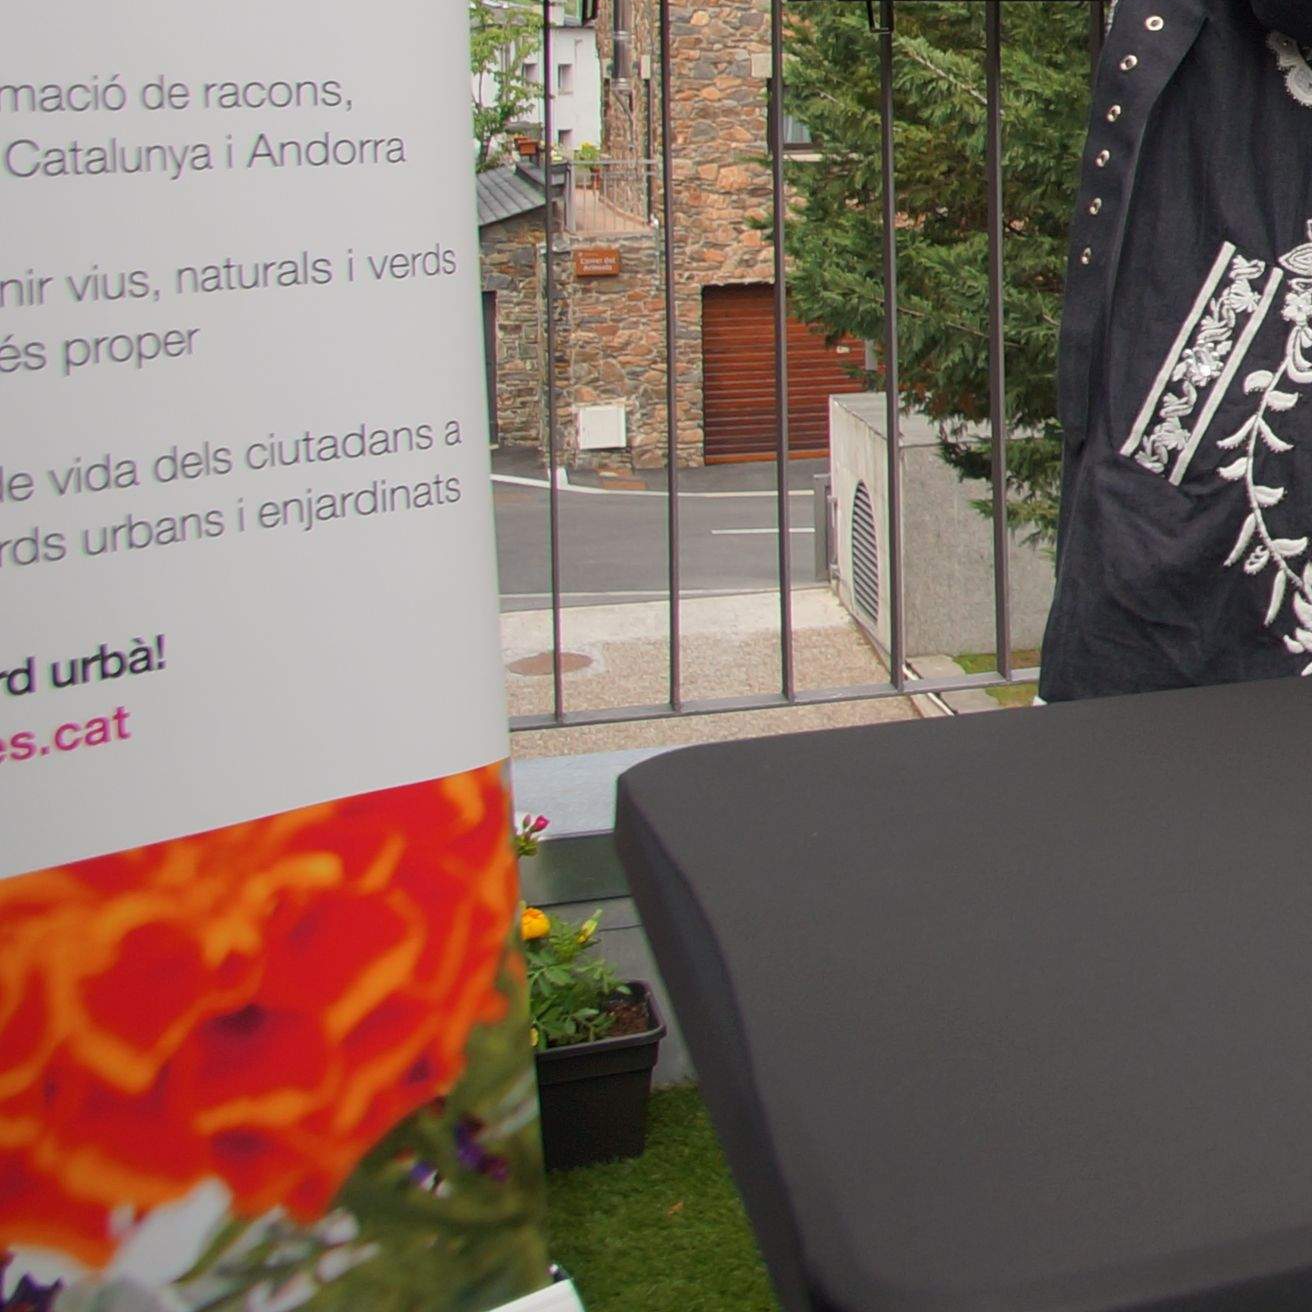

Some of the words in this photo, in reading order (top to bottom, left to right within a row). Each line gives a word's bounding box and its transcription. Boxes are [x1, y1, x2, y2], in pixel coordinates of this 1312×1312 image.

[0, 73, 126, 112] mació
[141, 74, 190, 110] de
[203, 80, 352, 112] racons,
[4, 138, 213, 180] Catalunya
[225, 134, 233, 169] i
[246, 132, 407, 169] Andorra
[0, 268, 53, 307] nir
[66, 264, 160, 303] vius,
[176, 251, 332, 294] naturals
[347, 249, 354, 282] i
[367, 243, 457, 280] verds
[0, 334, 46, 373] és
[64, 329, 200, 376] proper
[48, 454, 140, 496] vida
[153, 441, 233, 483] dels
[245, 422, 434, 471] ciutadans
[445, 419, 463, 446] a
[83, 510, 225, 556] urbans
[237, 498, 245, 532] i
[258, 473, 462, 532] enjardinats
[50, 634, 166, 689] urbà!
